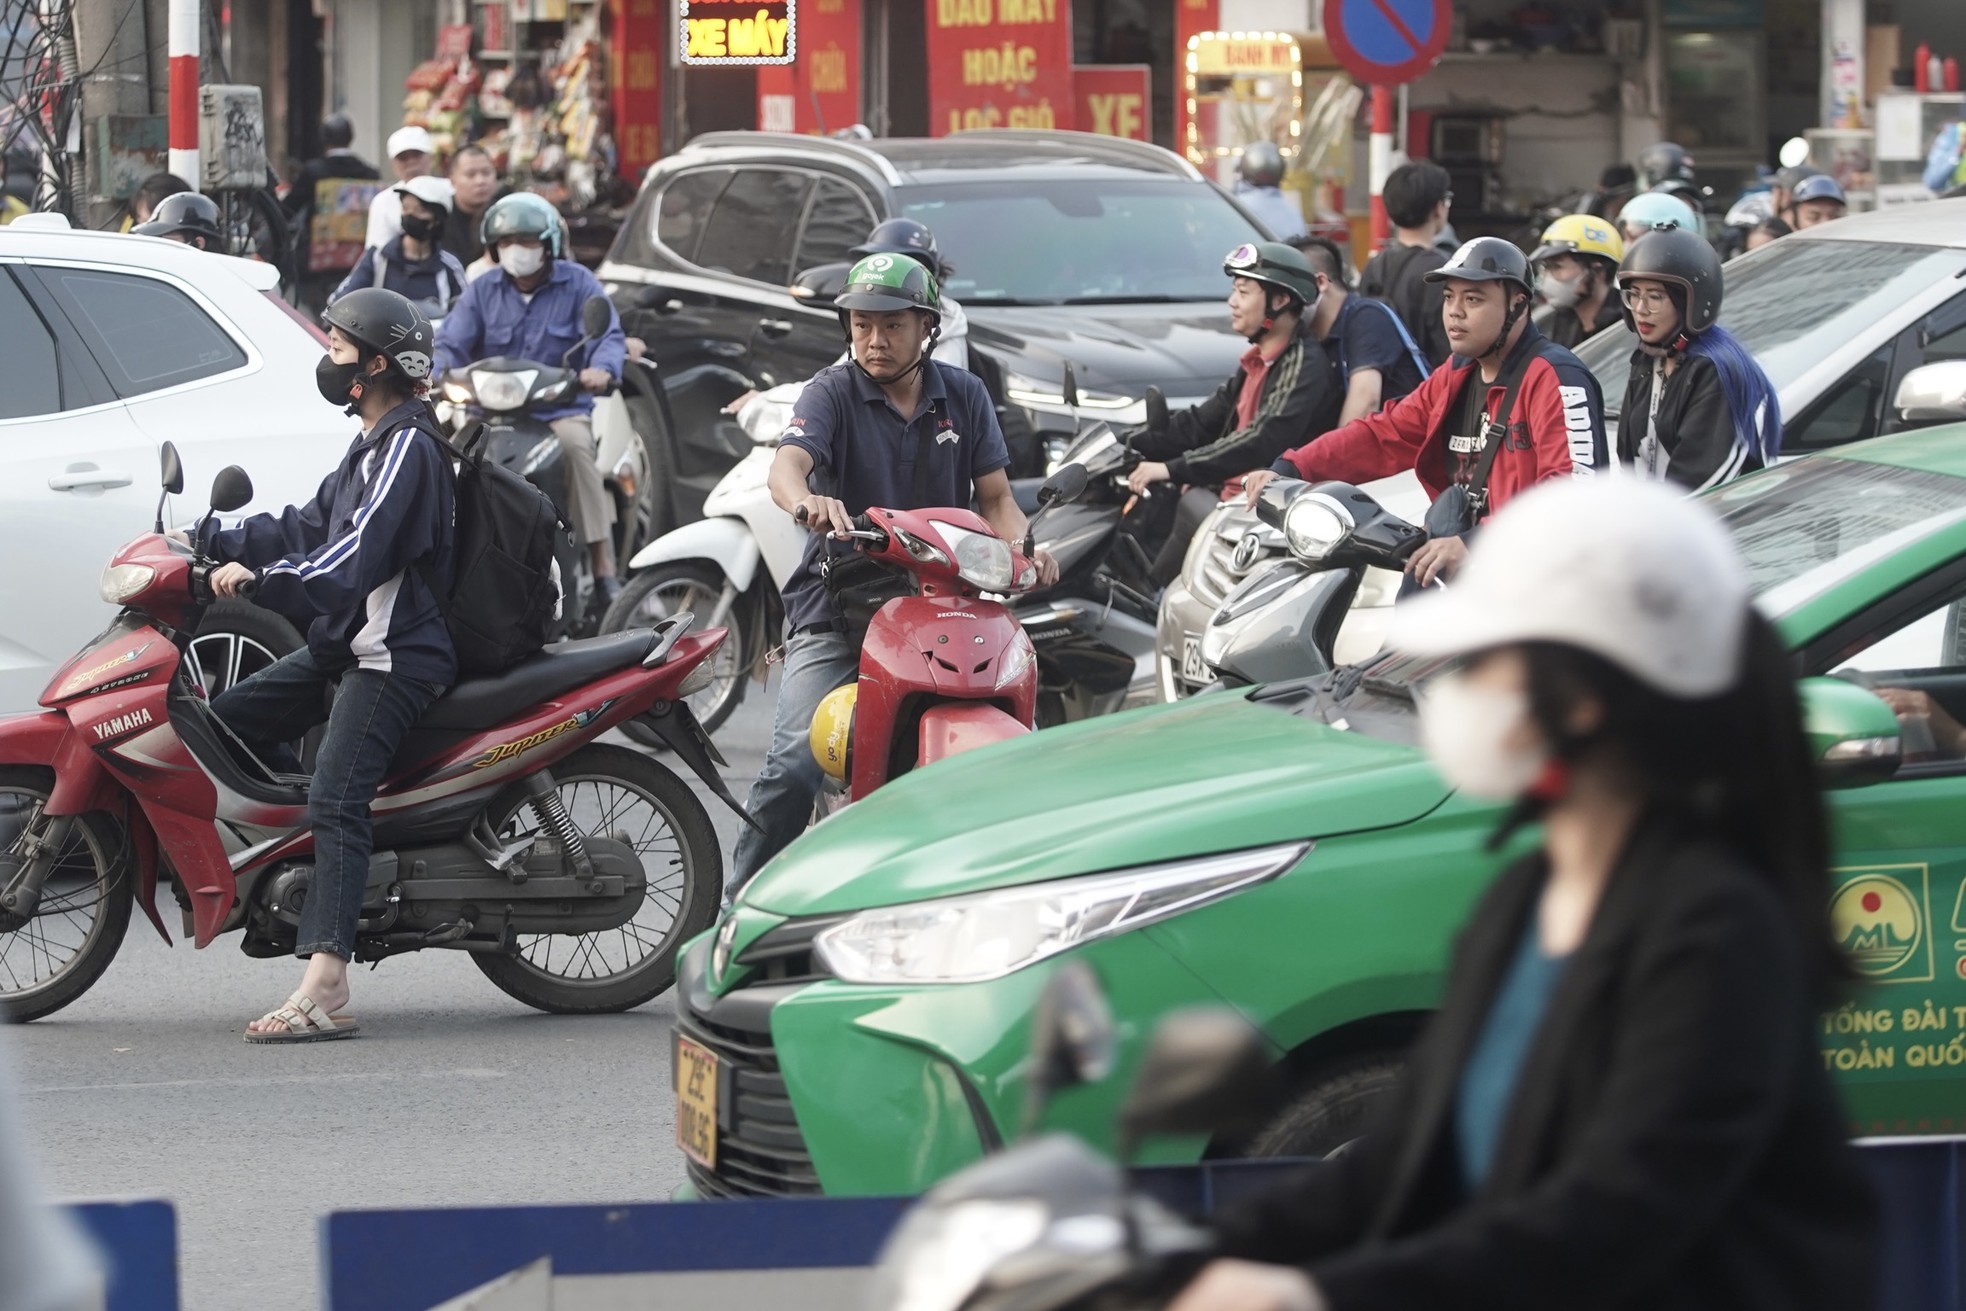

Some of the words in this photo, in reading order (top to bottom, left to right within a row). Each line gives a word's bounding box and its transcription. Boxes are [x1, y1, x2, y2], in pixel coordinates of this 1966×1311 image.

[687, 18, 727, 56] XE
[728, 9, 788, 56] MÁY
[962, 41, 1037, 91] HOẶC
[1088, 94, 1142, 138] XE
[1584, 223, 1608, 243] be
[862, 272, 885, 281] gojek
[1030, 627, 1072, 641] HONDA
[93, 708, 153, 739] YAMAHA
[1902, 998, 1947, 1031] ĐÀI
[1820, 1039, 1894, 1070] TOÀN
[1905, 1031, 1966, 1067] QUỐ
